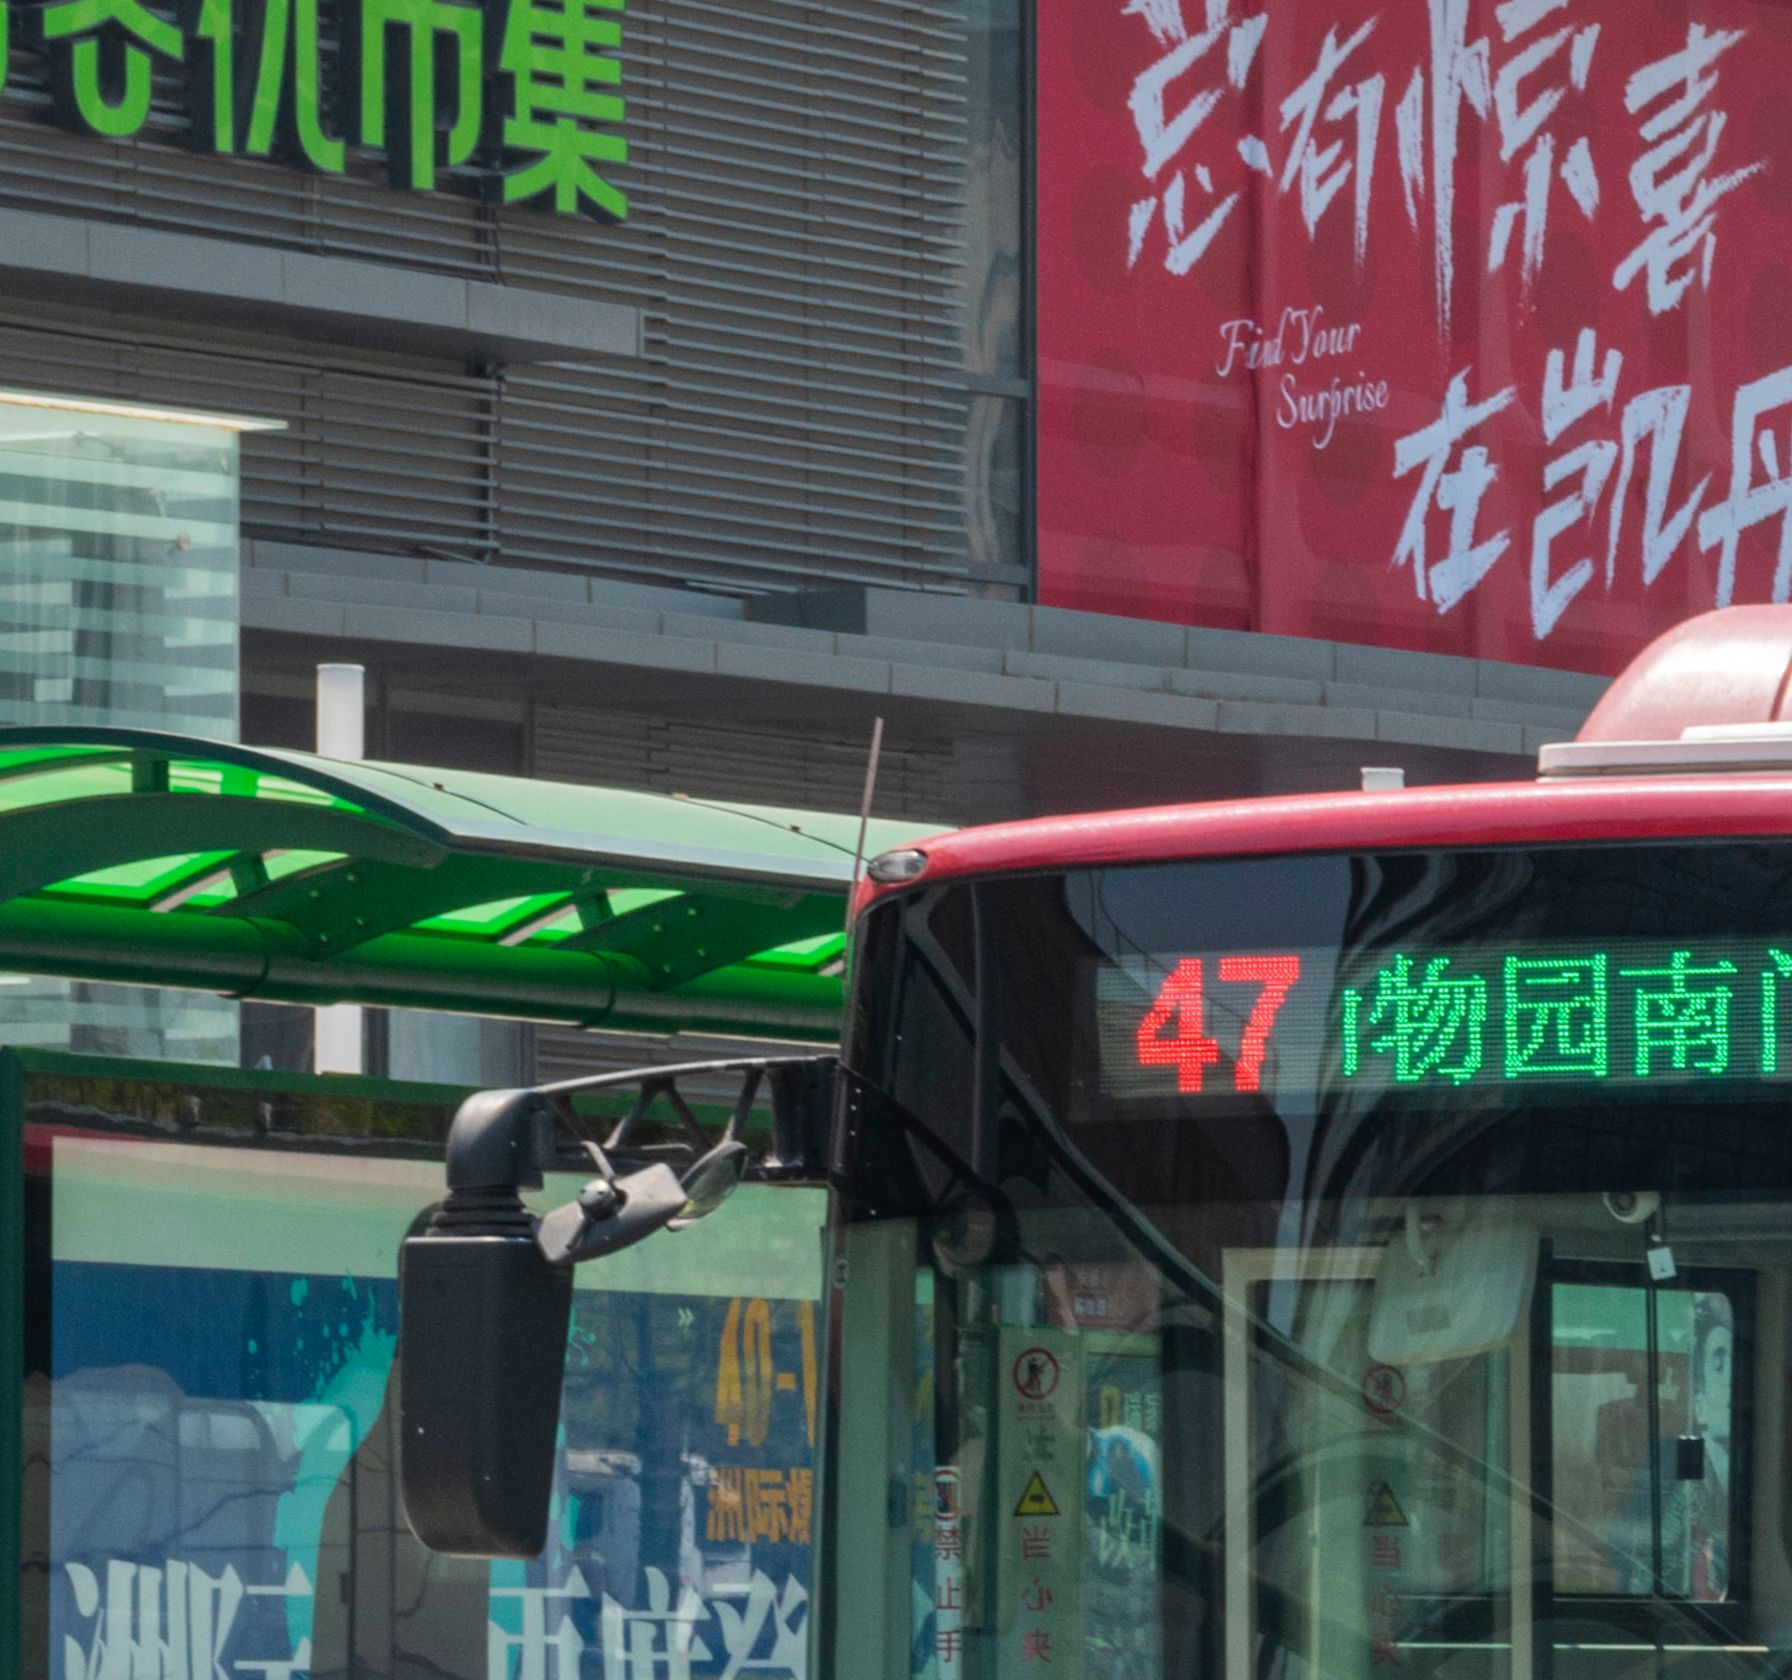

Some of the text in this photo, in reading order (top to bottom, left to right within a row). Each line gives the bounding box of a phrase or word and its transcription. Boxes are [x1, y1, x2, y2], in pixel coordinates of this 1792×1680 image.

[1216, 305, 1361, 377] Find Your
[1276, 372, 1389, 449] Surprise
[1136, 955, 1300, 1092] 47
